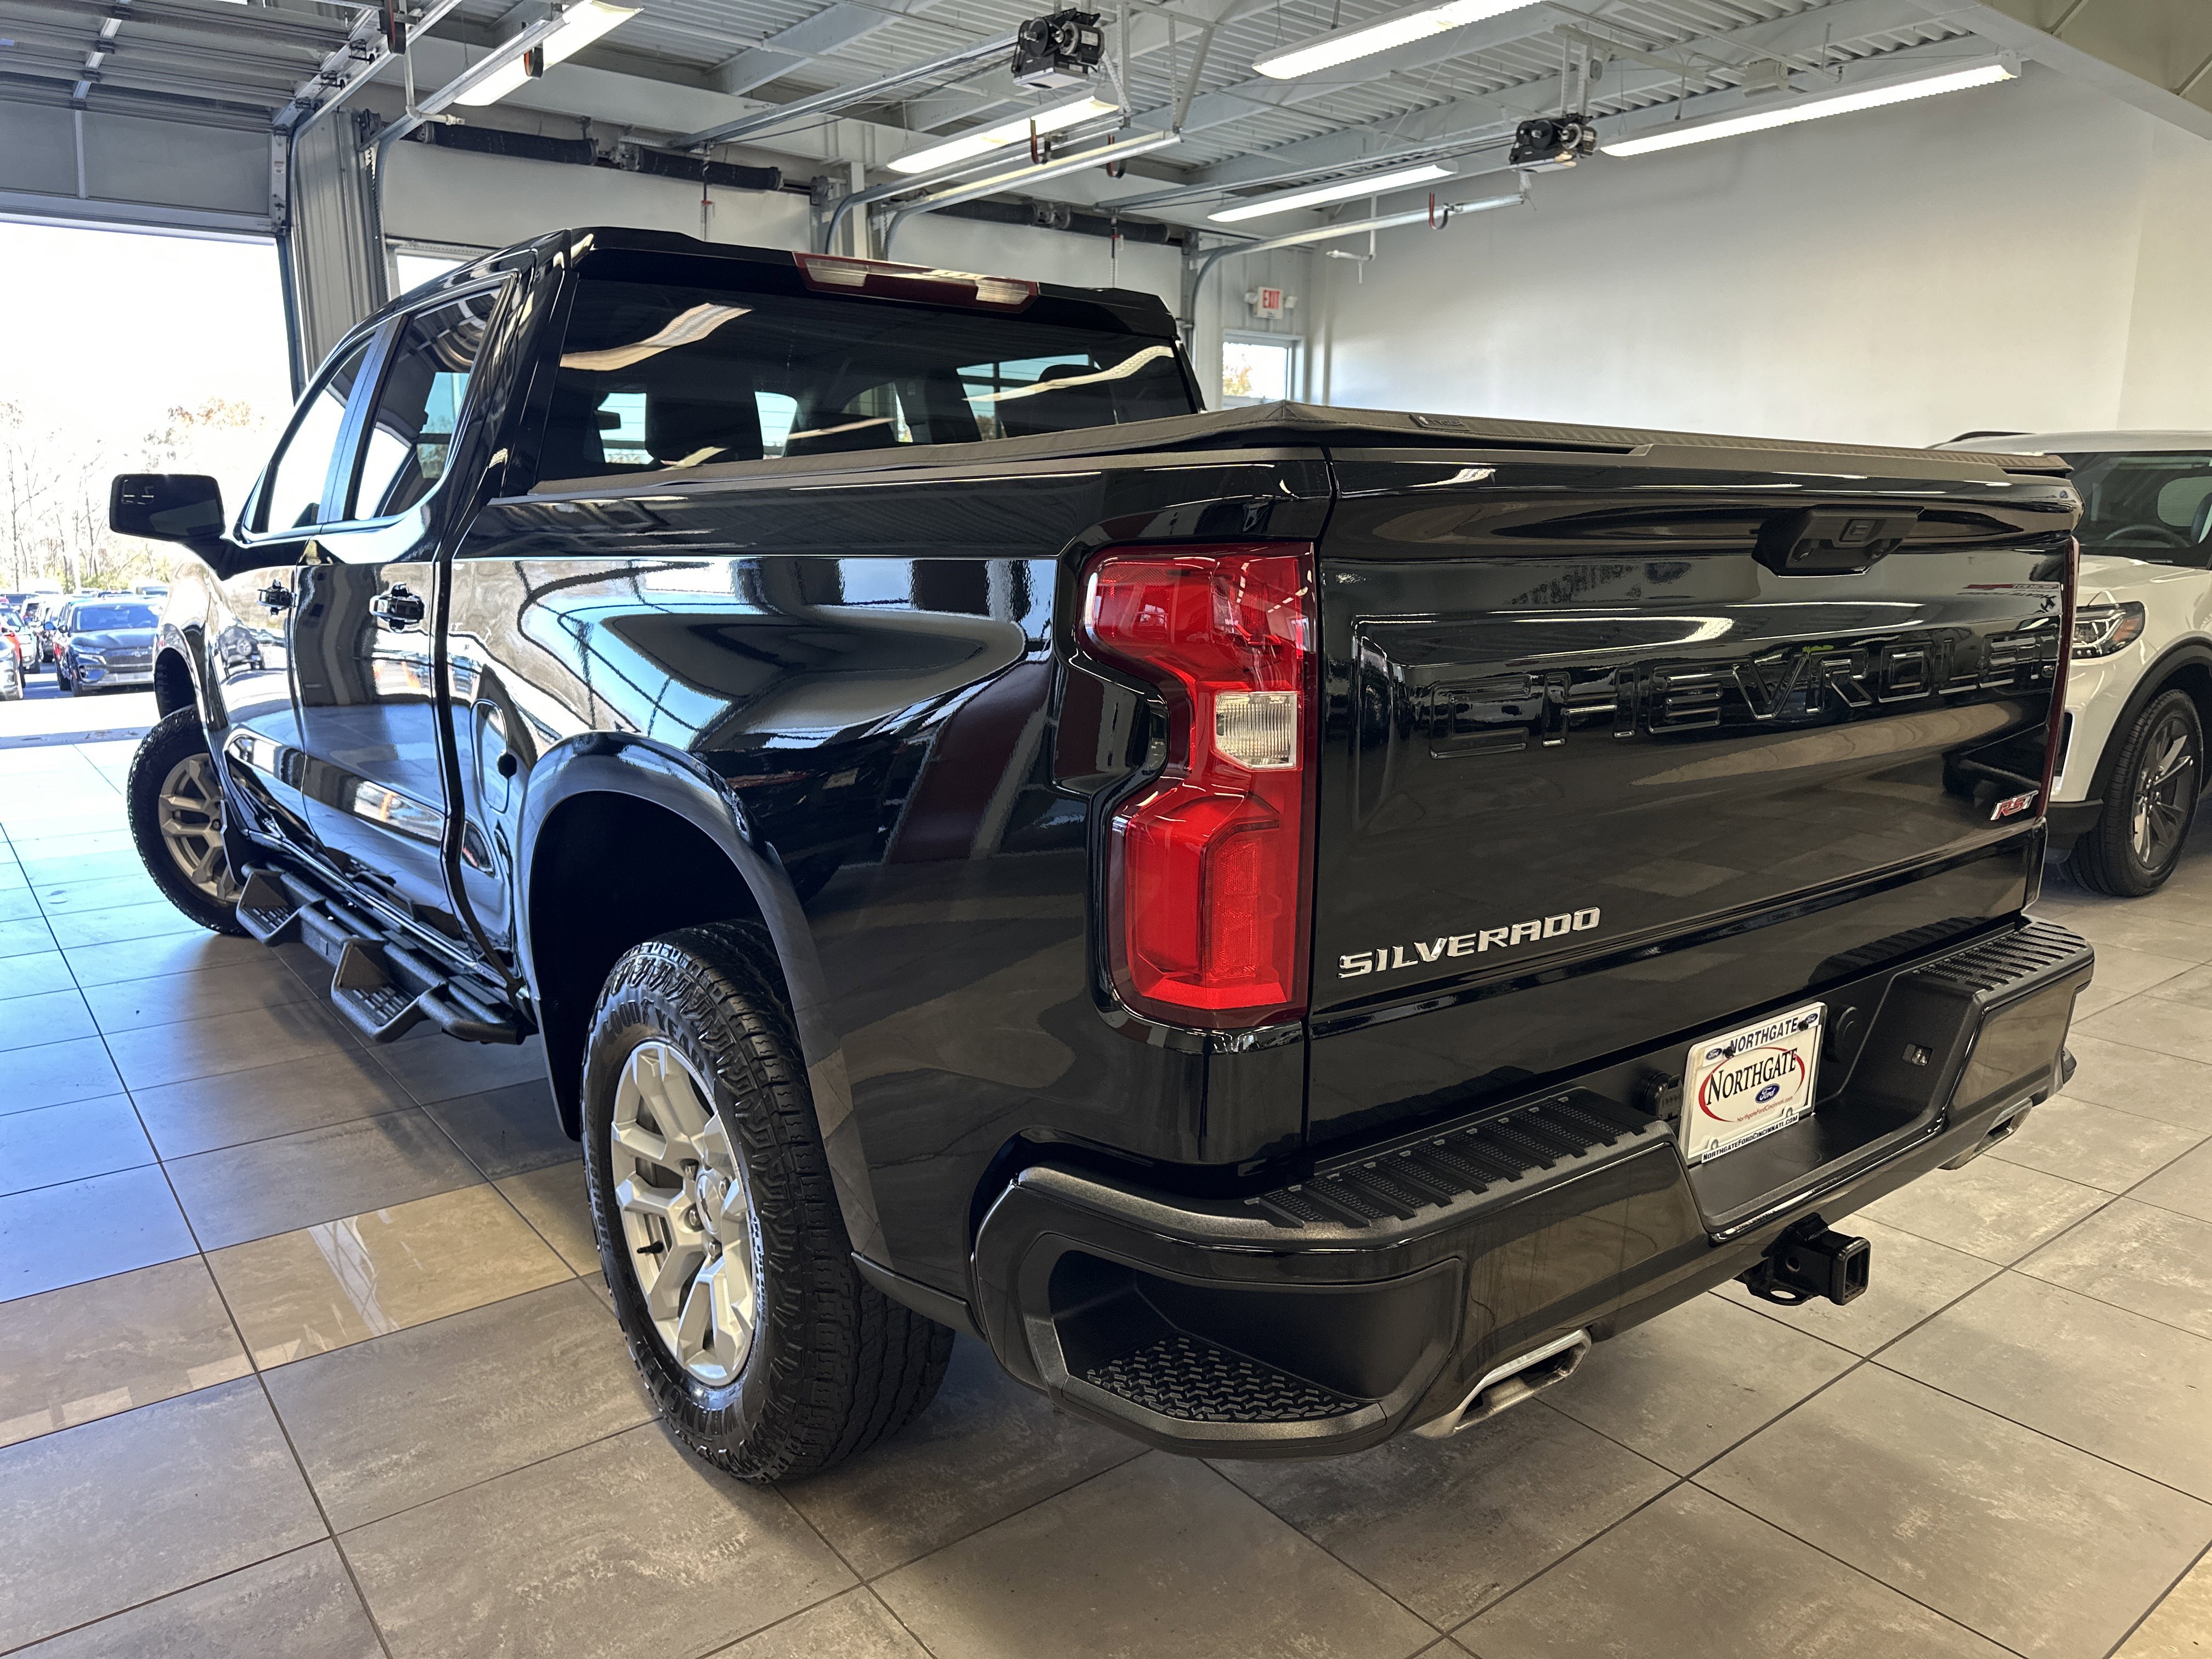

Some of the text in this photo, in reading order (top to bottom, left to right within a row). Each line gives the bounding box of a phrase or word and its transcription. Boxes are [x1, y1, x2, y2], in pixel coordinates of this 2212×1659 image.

[1263, 290, 1280, 309] EXIT
[1338, 906, 1601, 979] SILVERADO
[1730, 1017, 1798, 1054] NORTHGATE
[1706, 1048, 1798, 1105] NORTHGATE
[1758, 1085, 1778, 1102] Ford
